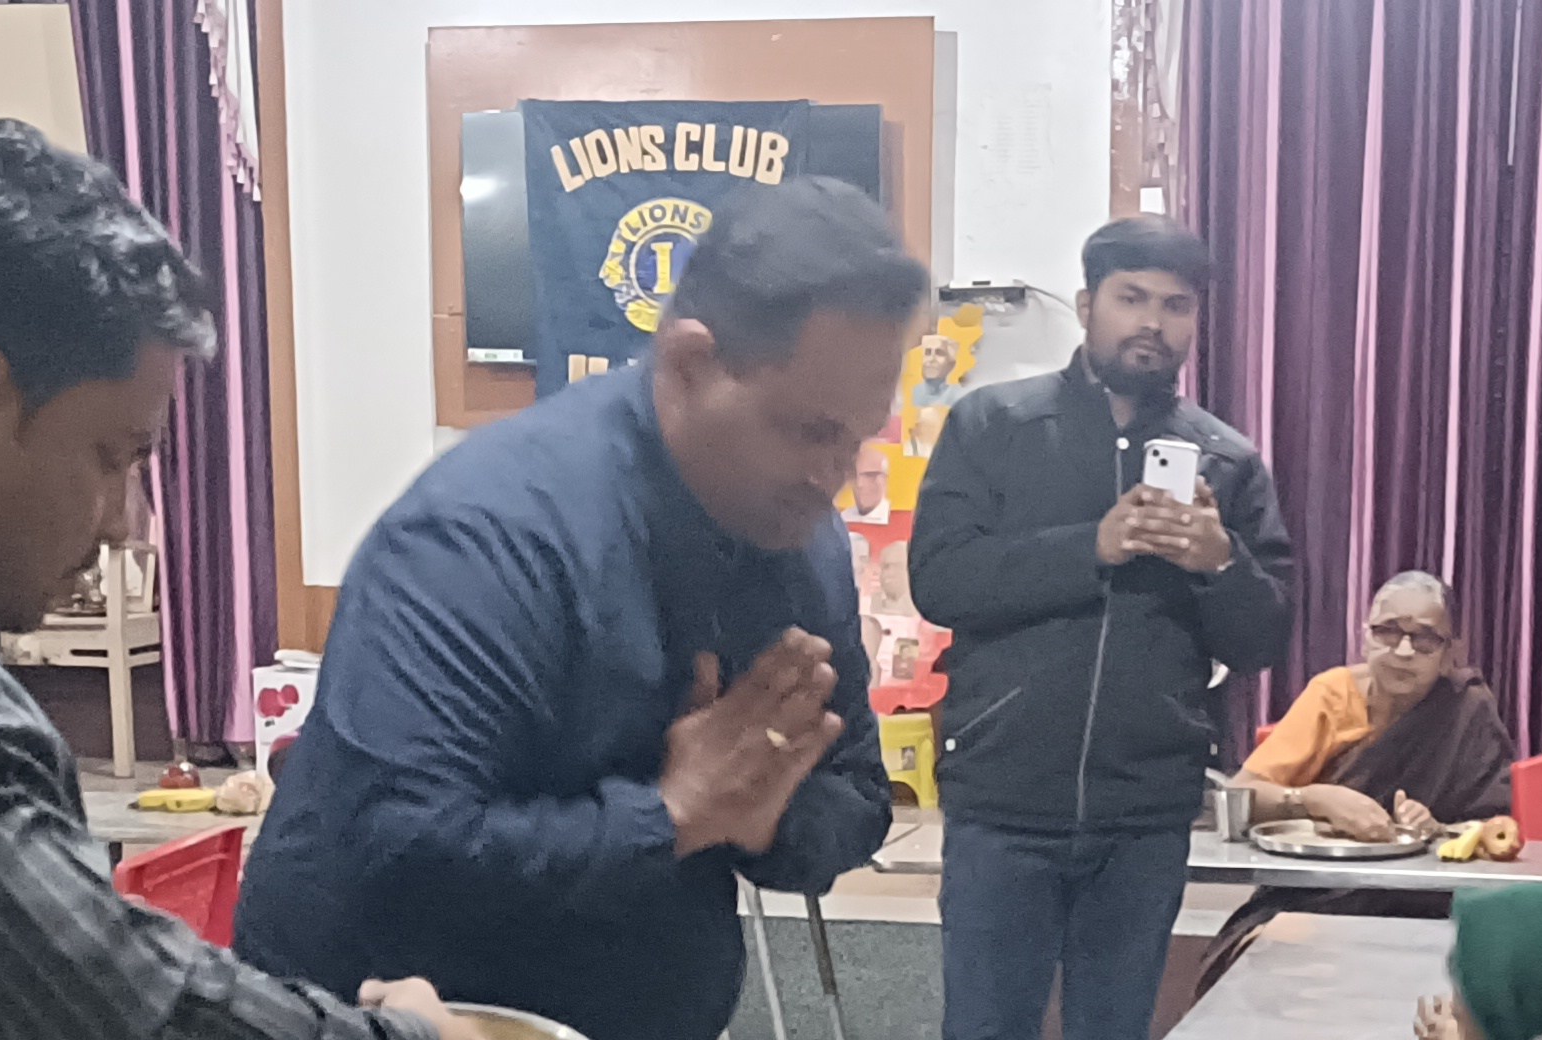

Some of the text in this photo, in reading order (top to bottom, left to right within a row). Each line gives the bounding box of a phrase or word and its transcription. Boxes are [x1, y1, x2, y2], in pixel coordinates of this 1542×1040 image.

[550, 122, 789, 192] LIONS CLUB
[624, 204, 706, 236] LIONS
